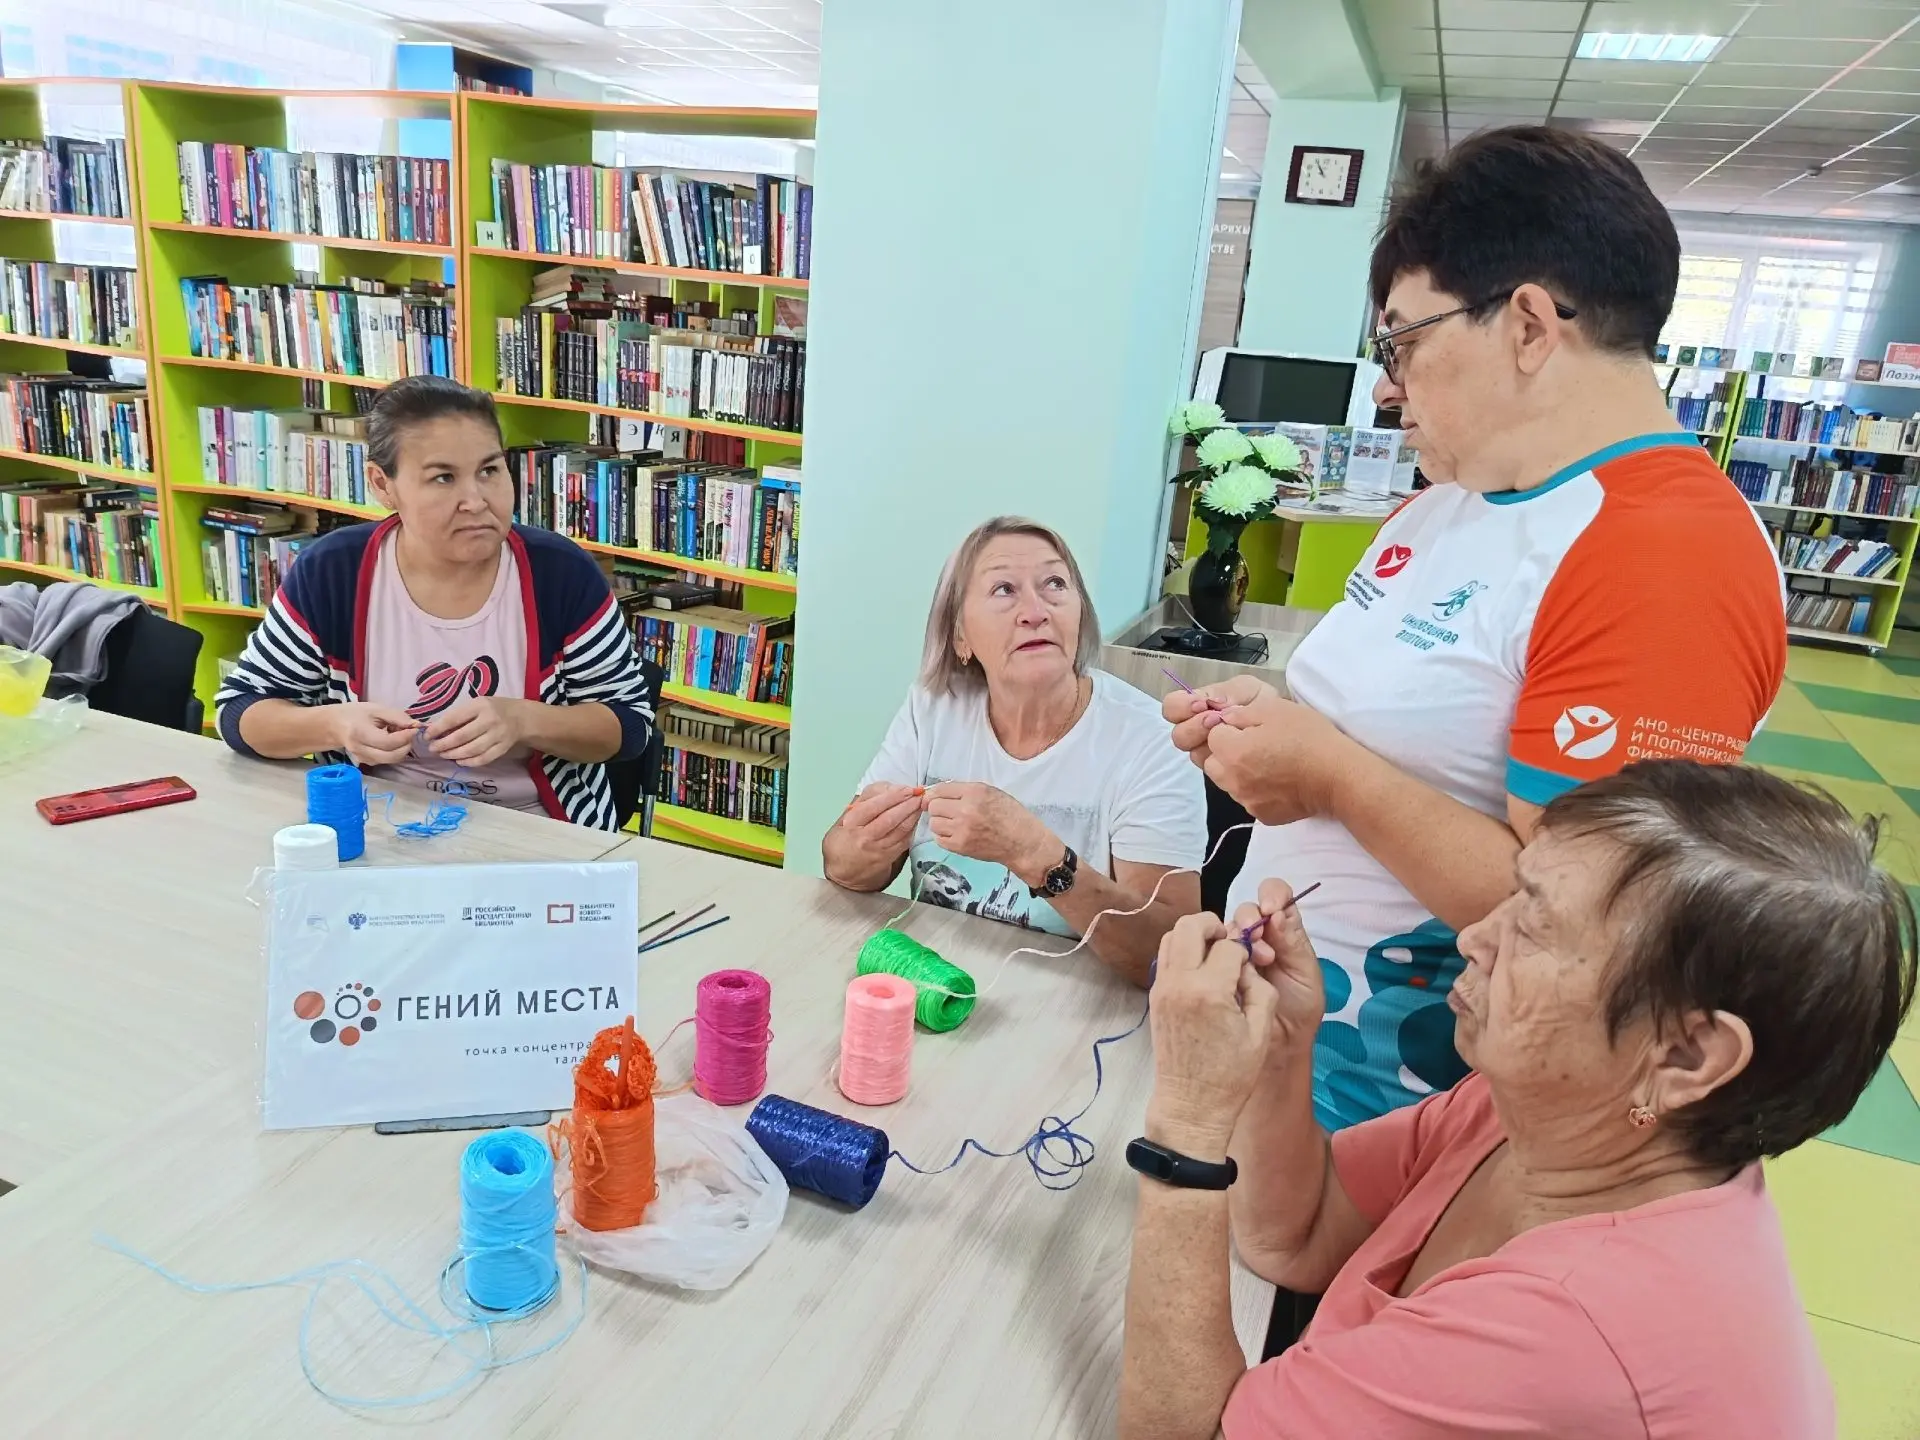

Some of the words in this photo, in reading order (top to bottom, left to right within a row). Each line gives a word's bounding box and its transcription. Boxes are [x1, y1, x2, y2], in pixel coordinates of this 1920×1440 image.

[1634, 716, 1668, 733] АНО
[1630, 730, 1643, 743] И
[397, 988, 501, 1022] ГЕНИЙ
[517, 986, 620, 1015] МЕСТА
[464, 1046, 508, 1056] точка
